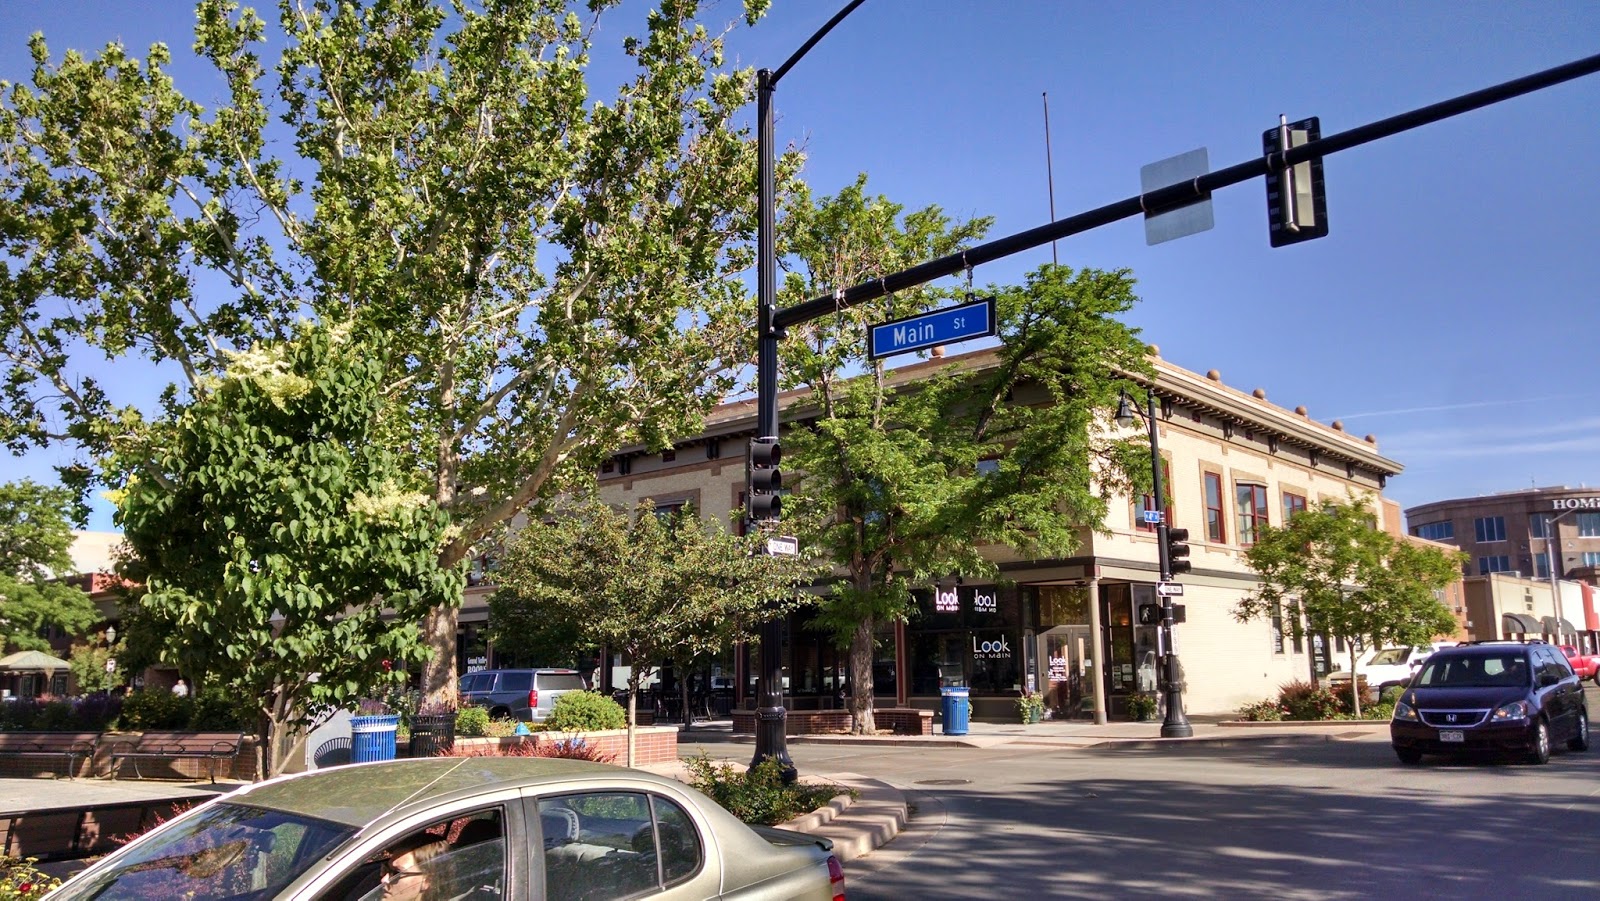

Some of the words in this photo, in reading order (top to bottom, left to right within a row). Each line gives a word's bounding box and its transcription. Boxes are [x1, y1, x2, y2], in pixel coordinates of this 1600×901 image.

[894, 322, 934, 346] Main
[953, 317, 966, 330] St
[773, 542, 783, 552] ONE
[784, 544, 794, 553] WAY
[935, 587, 960, 605] Look
[973, 634, 1011, 653] Look
[1049, 655, 1067, 664] Look
